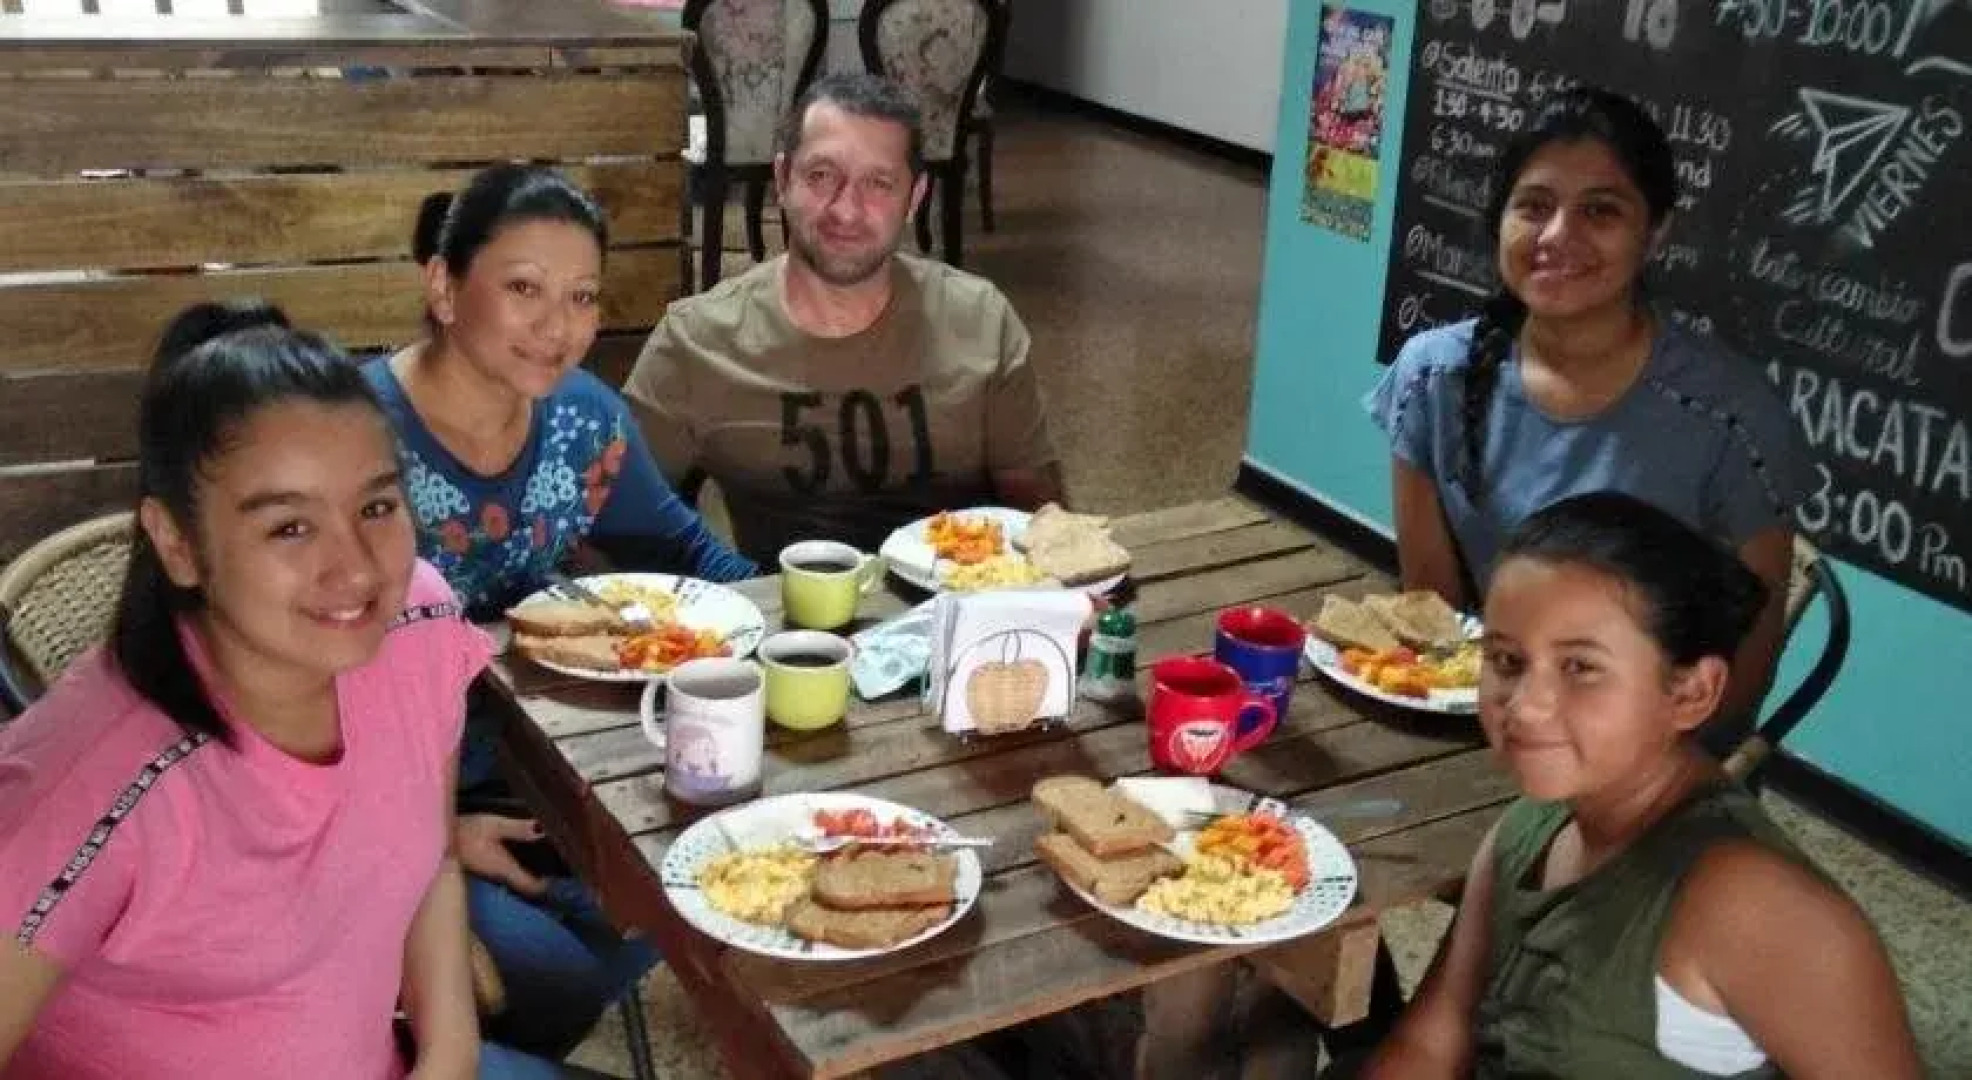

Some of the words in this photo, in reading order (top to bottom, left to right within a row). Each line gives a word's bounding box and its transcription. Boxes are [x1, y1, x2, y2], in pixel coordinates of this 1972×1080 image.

[1847, 94, 1966, 248] VIERNES
[779, 384, 933, 490] 501
[1796, 463, 1912, 563] 3:00
